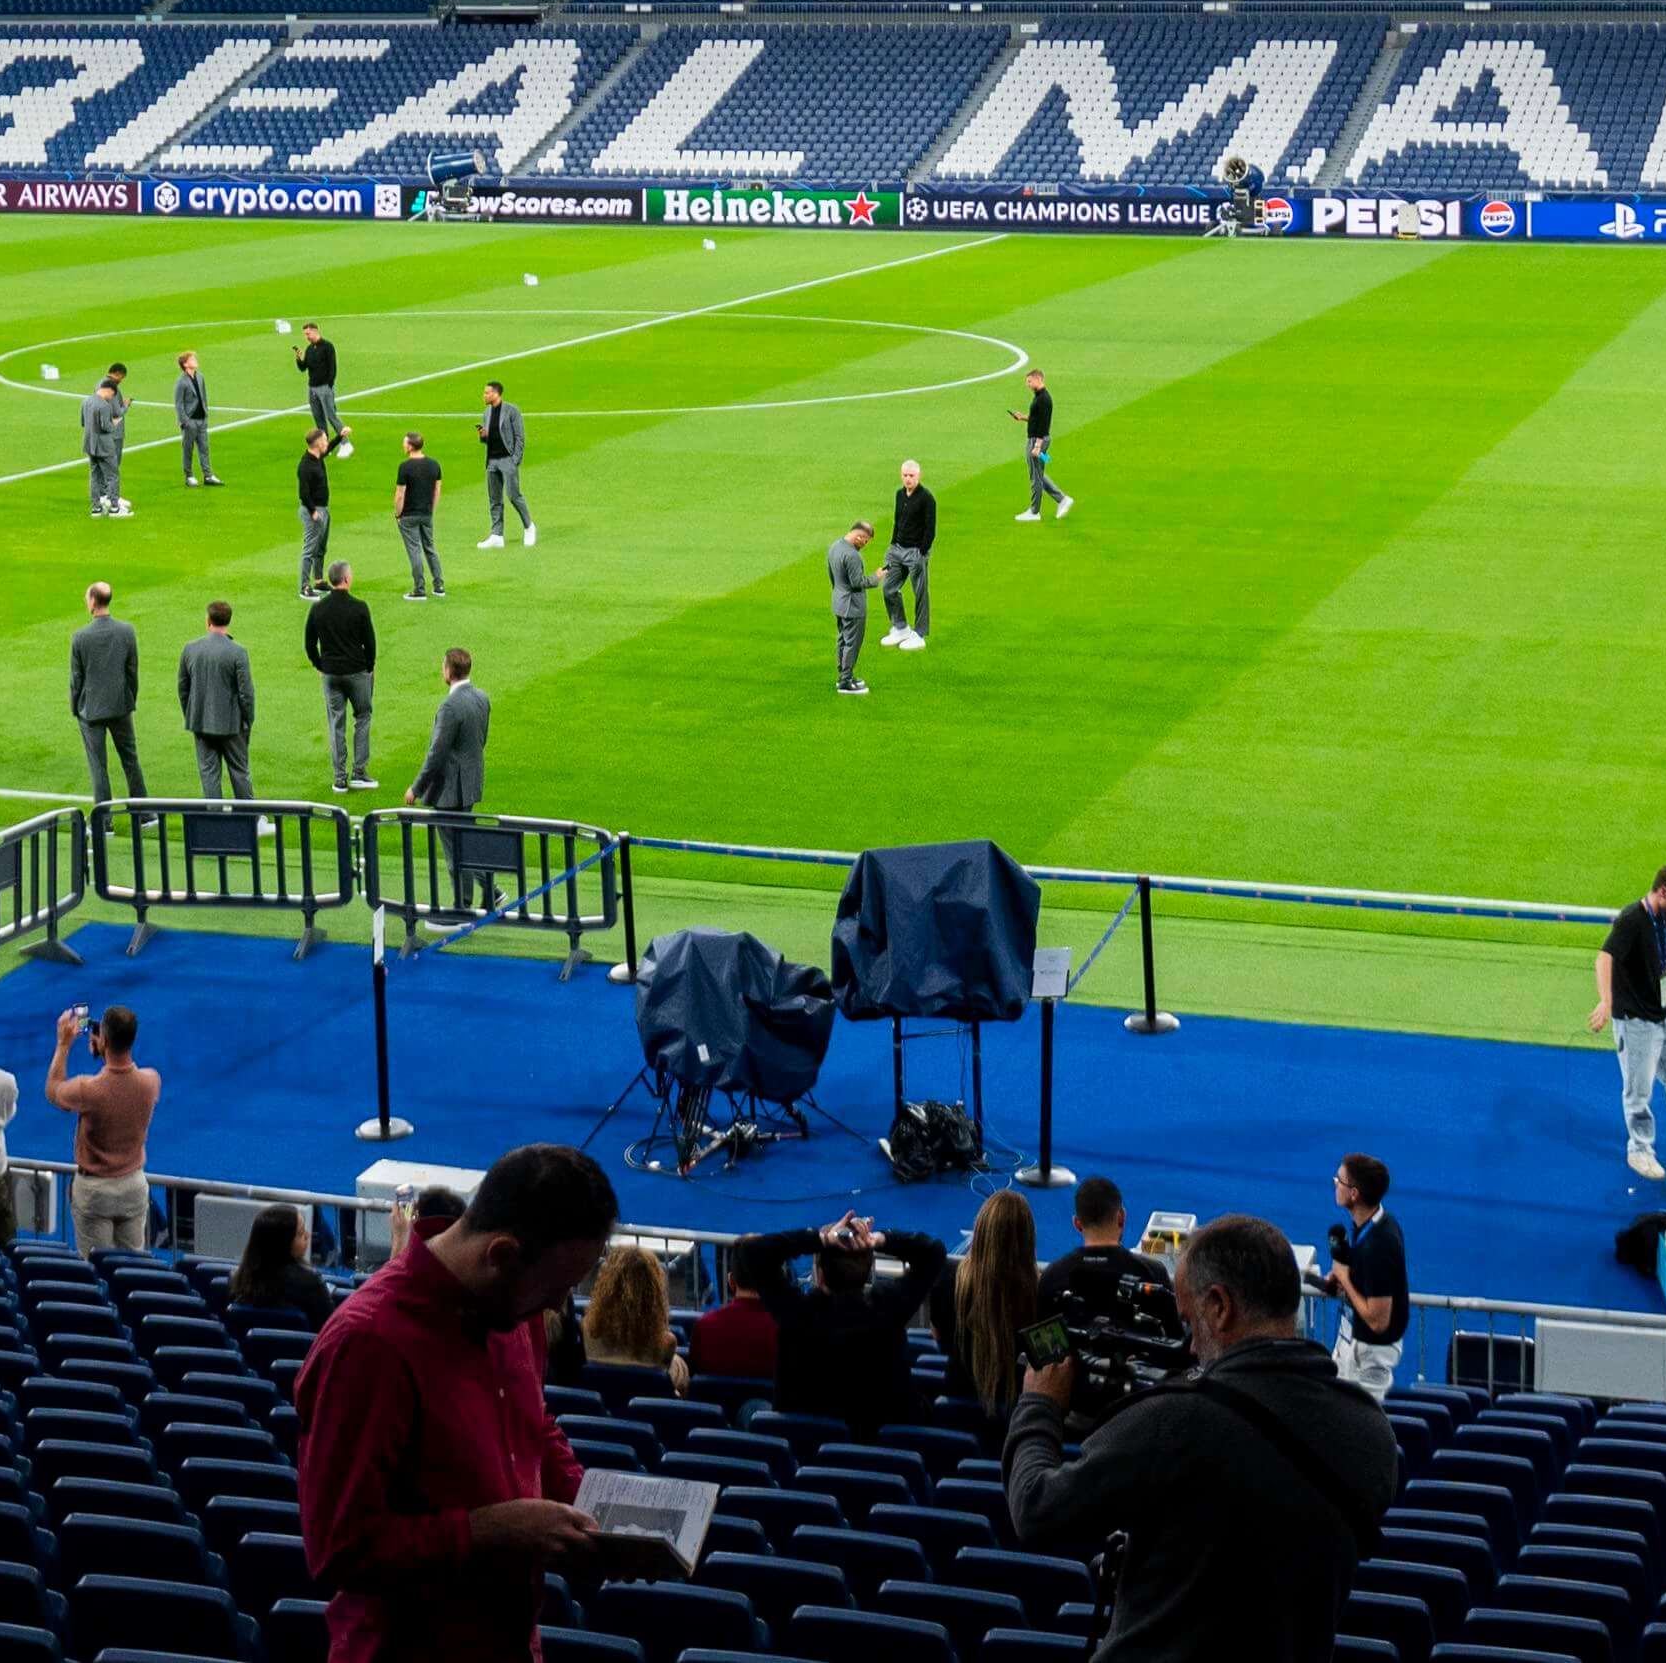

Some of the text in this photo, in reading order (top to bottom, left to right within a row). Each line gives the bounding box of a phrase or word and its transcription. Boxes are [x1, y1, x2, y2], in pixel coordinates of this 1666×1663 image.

[18, 182, 128, 208] AIRWAYS
[188, 184, 361, 215] crypto.com
[663, 190, 841, 224] Heineken
[933, 200, 1210, 223] UEFA CHAMPIONS LEAGUE
[1312, 198, 1461, 235] PEPSI
